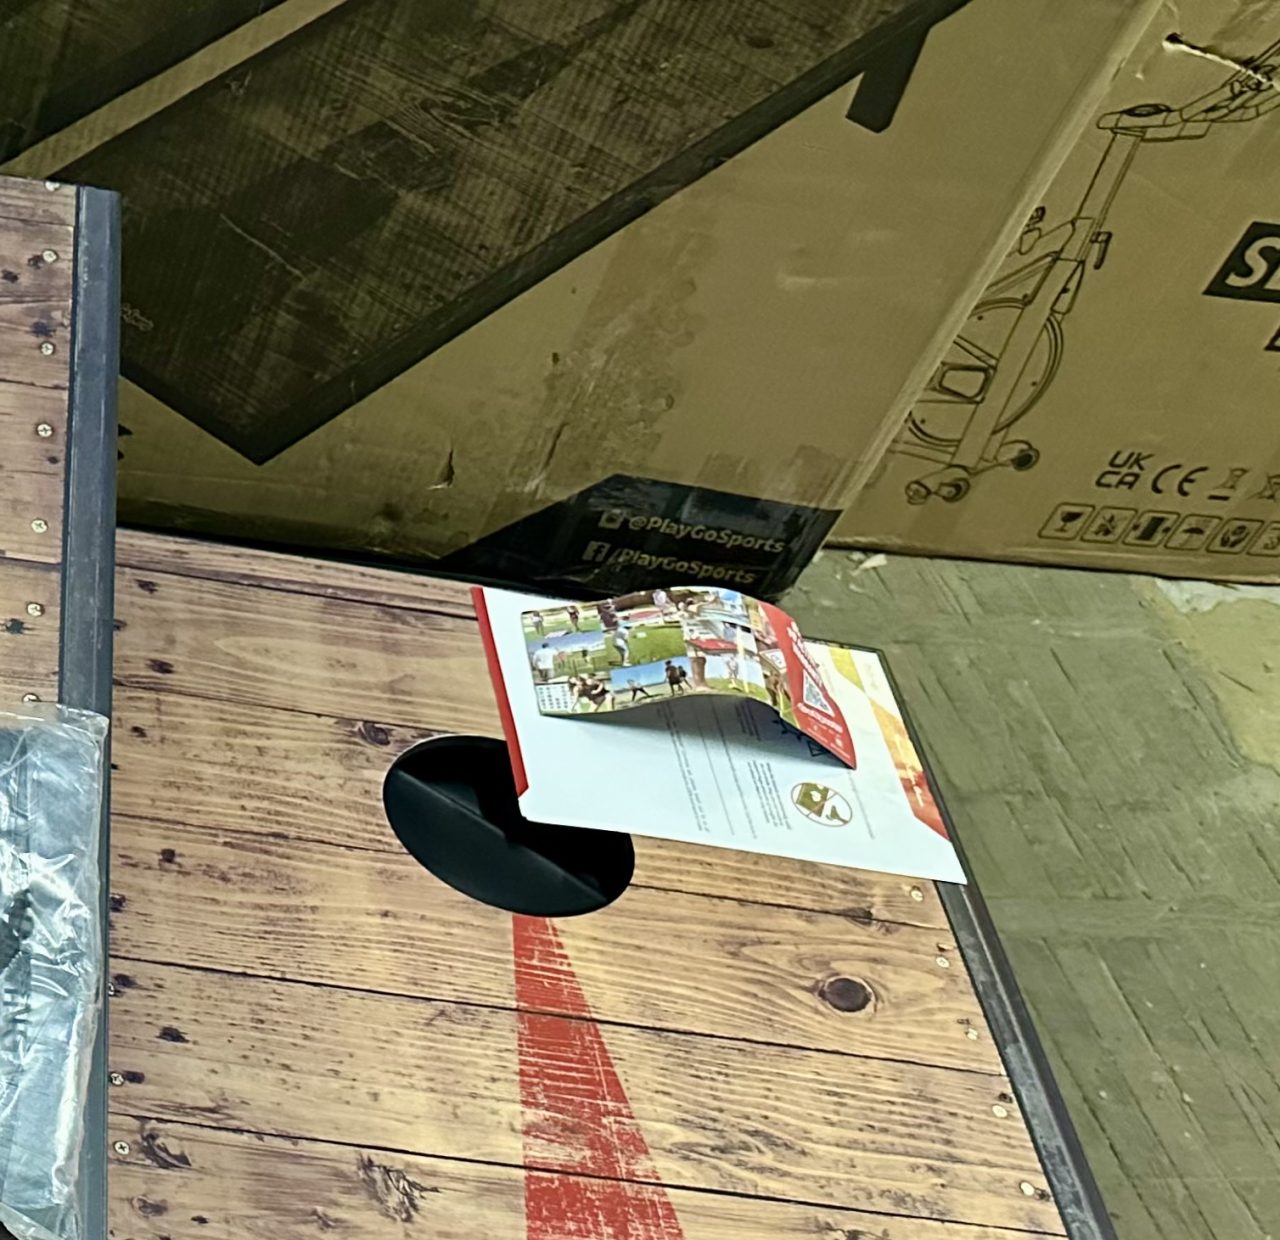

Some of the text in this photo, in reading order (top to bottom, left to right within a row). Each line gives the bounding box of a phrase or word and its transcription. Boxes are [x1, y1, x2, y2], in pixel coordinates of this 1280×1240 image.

[1225, 236, 1280, 292] S
[1109, 450, 1155, 471] UK
[1095, 470, 1141, 490] CA
[1151, 463, 1209, 497] CE
[628, 515, 785, 553] @PlayGoSports
